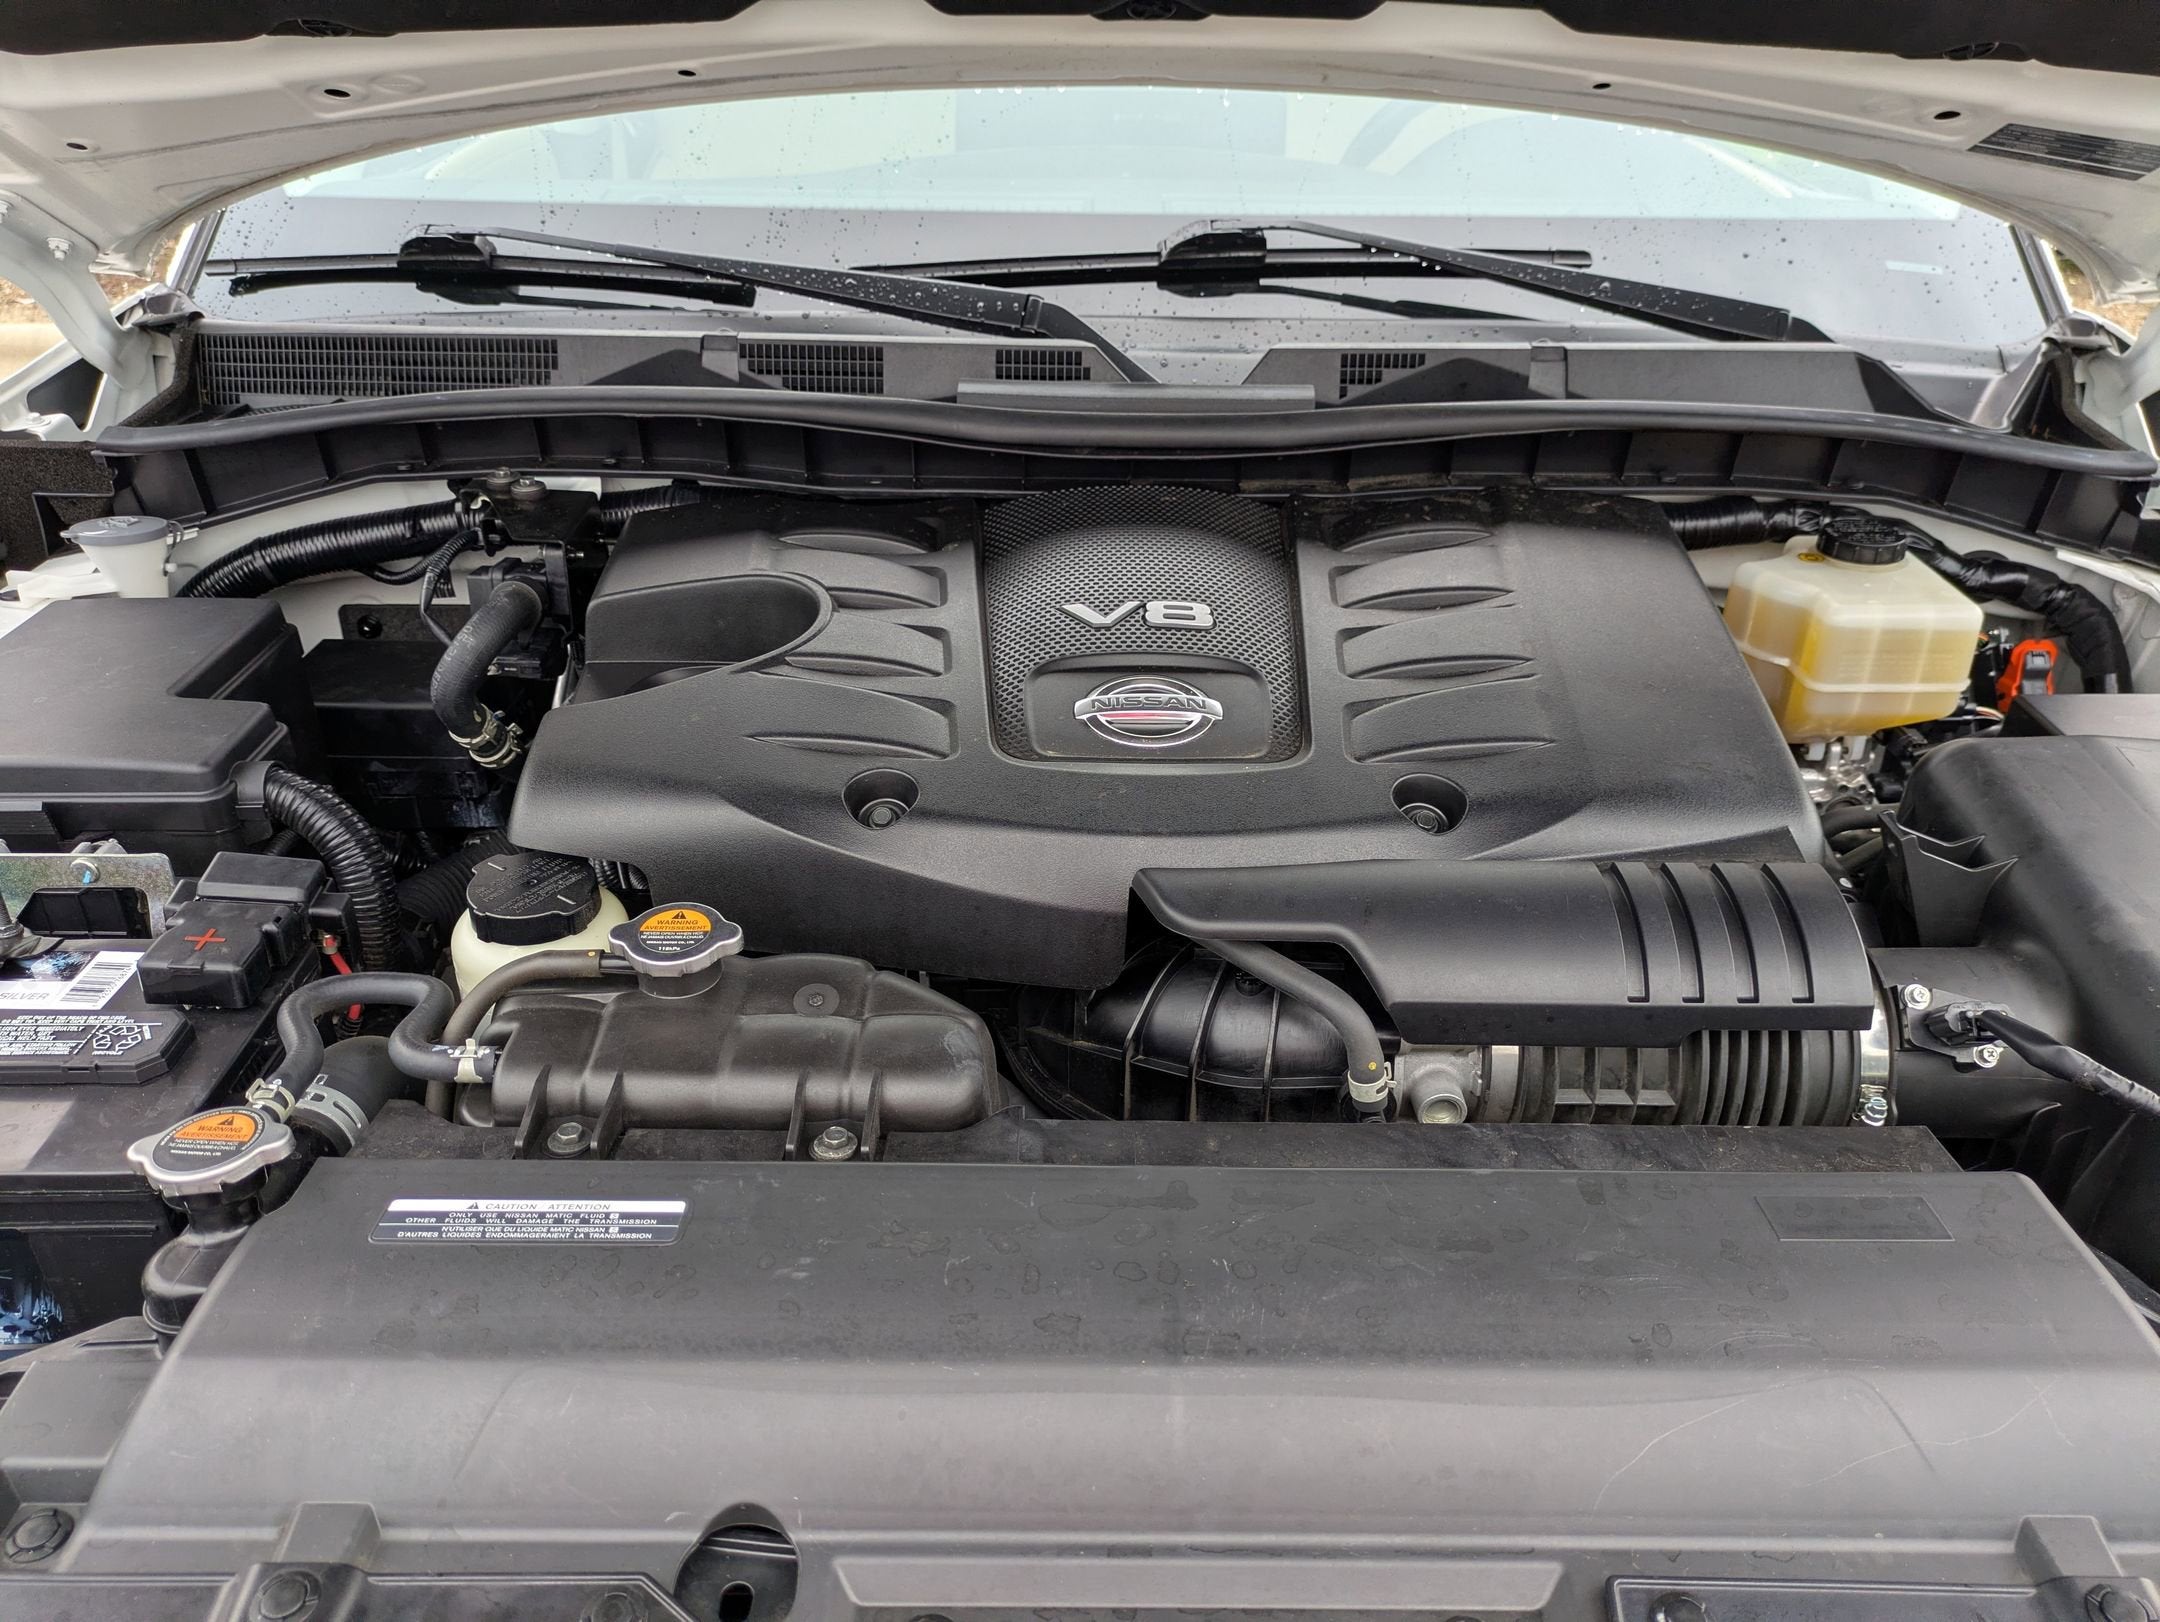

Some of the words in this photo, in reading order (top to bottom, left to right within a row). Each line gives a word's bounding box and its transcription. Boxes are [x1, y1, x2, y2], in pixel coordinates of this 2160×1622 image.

[1057, 600, 1217, 630] V8
[1091, 696, 1208, 710] NISSAN
[0, 992, 50, 1000] SILVER
